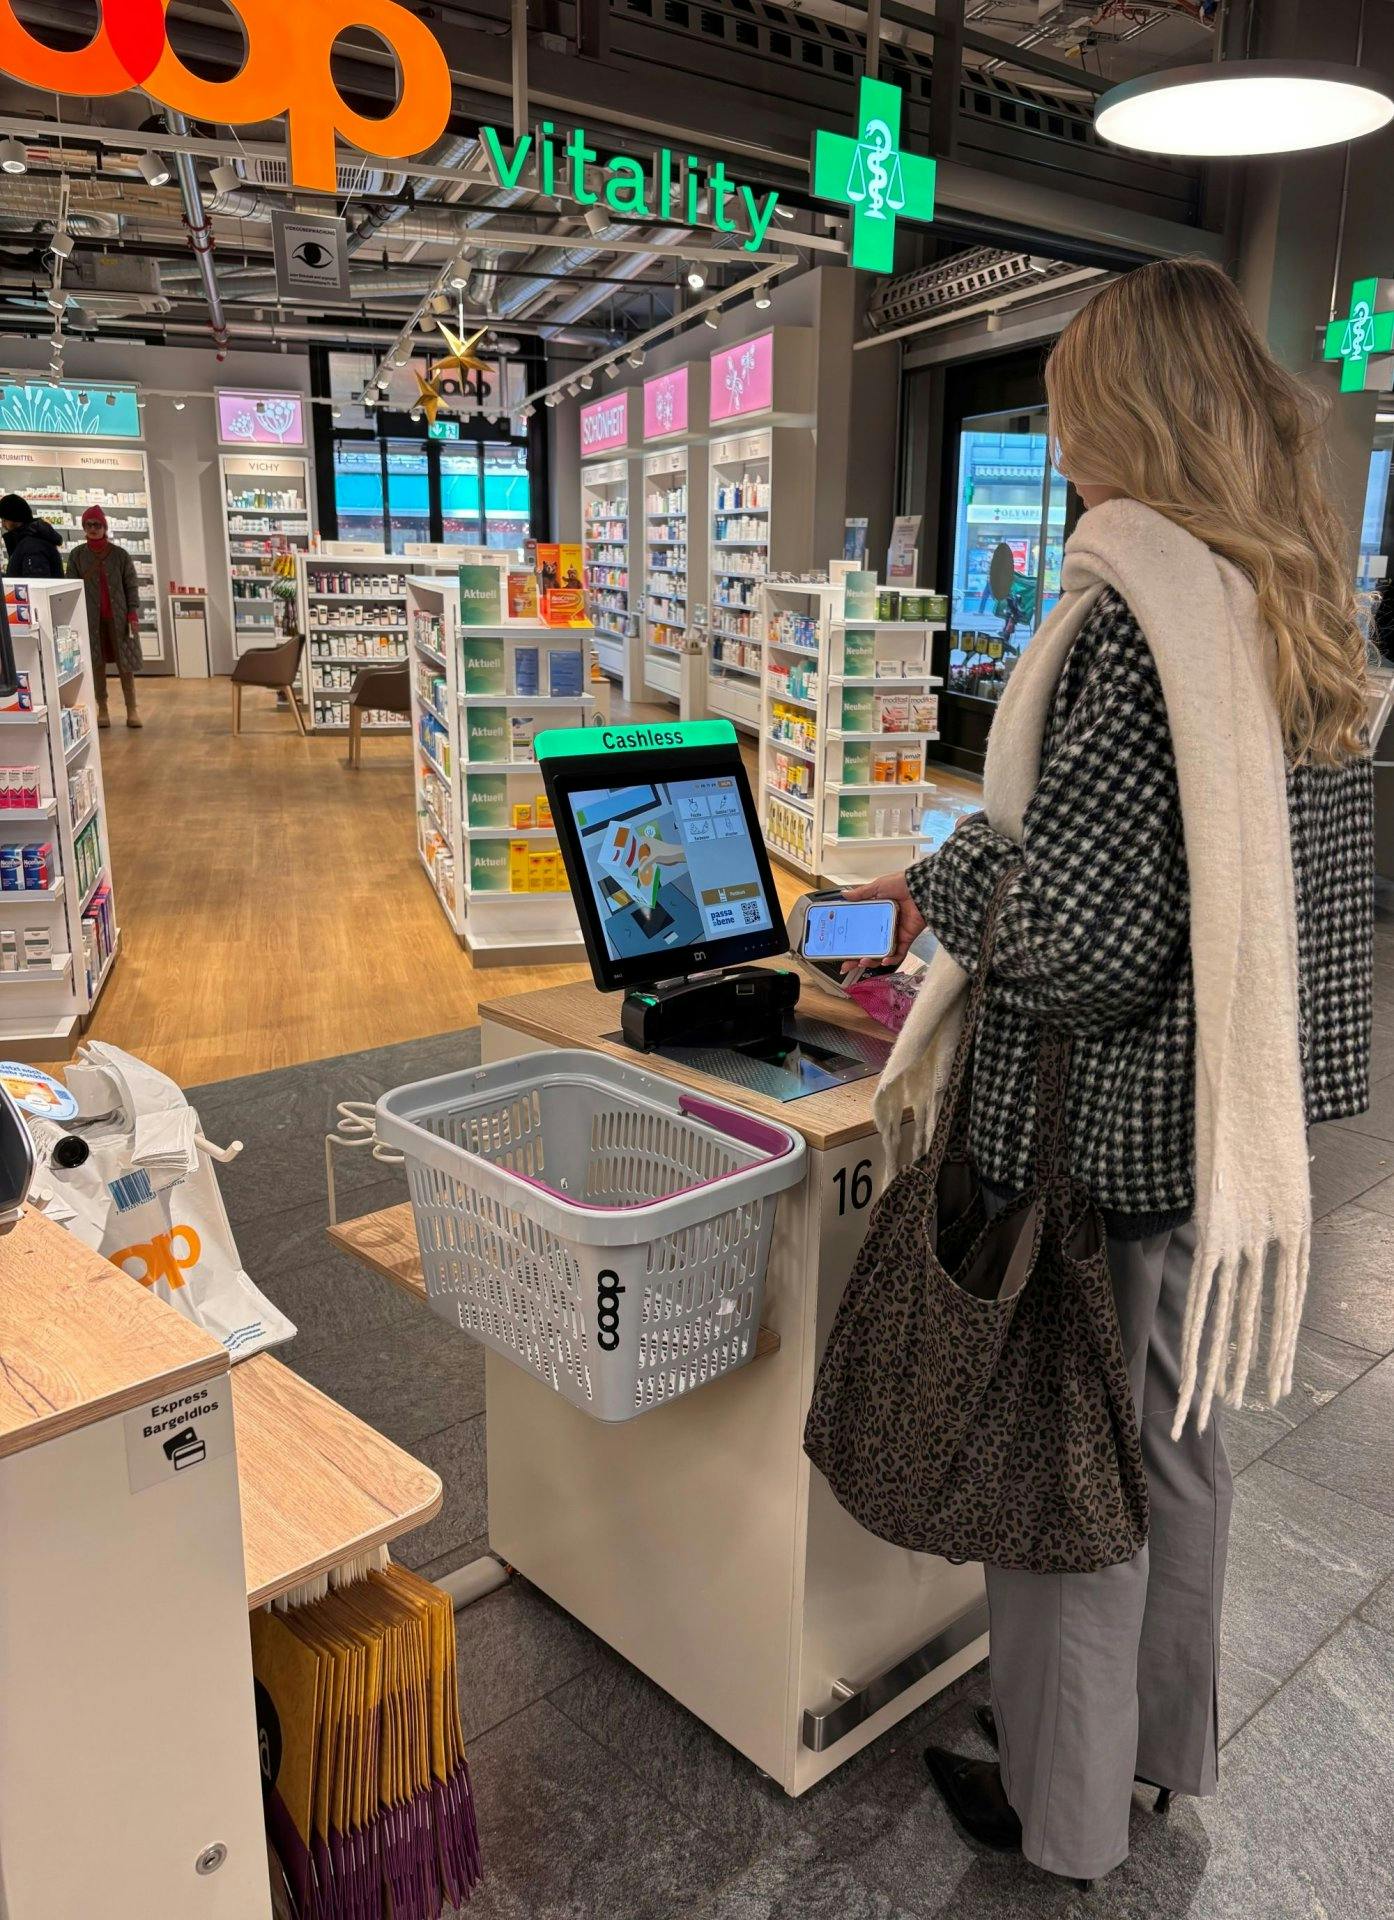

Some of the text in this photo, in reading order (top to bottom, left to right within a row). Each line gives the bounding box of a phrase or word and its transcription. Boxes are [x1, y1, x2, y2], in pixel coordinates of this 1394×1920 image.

[479, 121, 779, 252] vitality
[583, 405, 625, 445] SCHÖNHEIT
[80, 458, 119, 466] NATURMITTEL
[249, 462, 280, 472] VICHY
[463, 589, 497, 600] Aktuell
[846, 646, 873, 655] Neuheit
[468, 658, 501, 669] Aktuell
[843, 703, 872, 712] Neuheit
[471, 727, 504, 738] Aktuell
[602, 730, 684, 750] Cashless
[471, 793, 504, 803] Aktuell
[840, 810, 868, 819] Neuheit
[474, 857, 507, 868] Aktuell
[832, 1158, 873, 1217] 16
[597, 1269, 626, 1351] coop
[151, 1389, 208, 1418] Express
[143, 1401, 219, 1438] Bargeldlos
